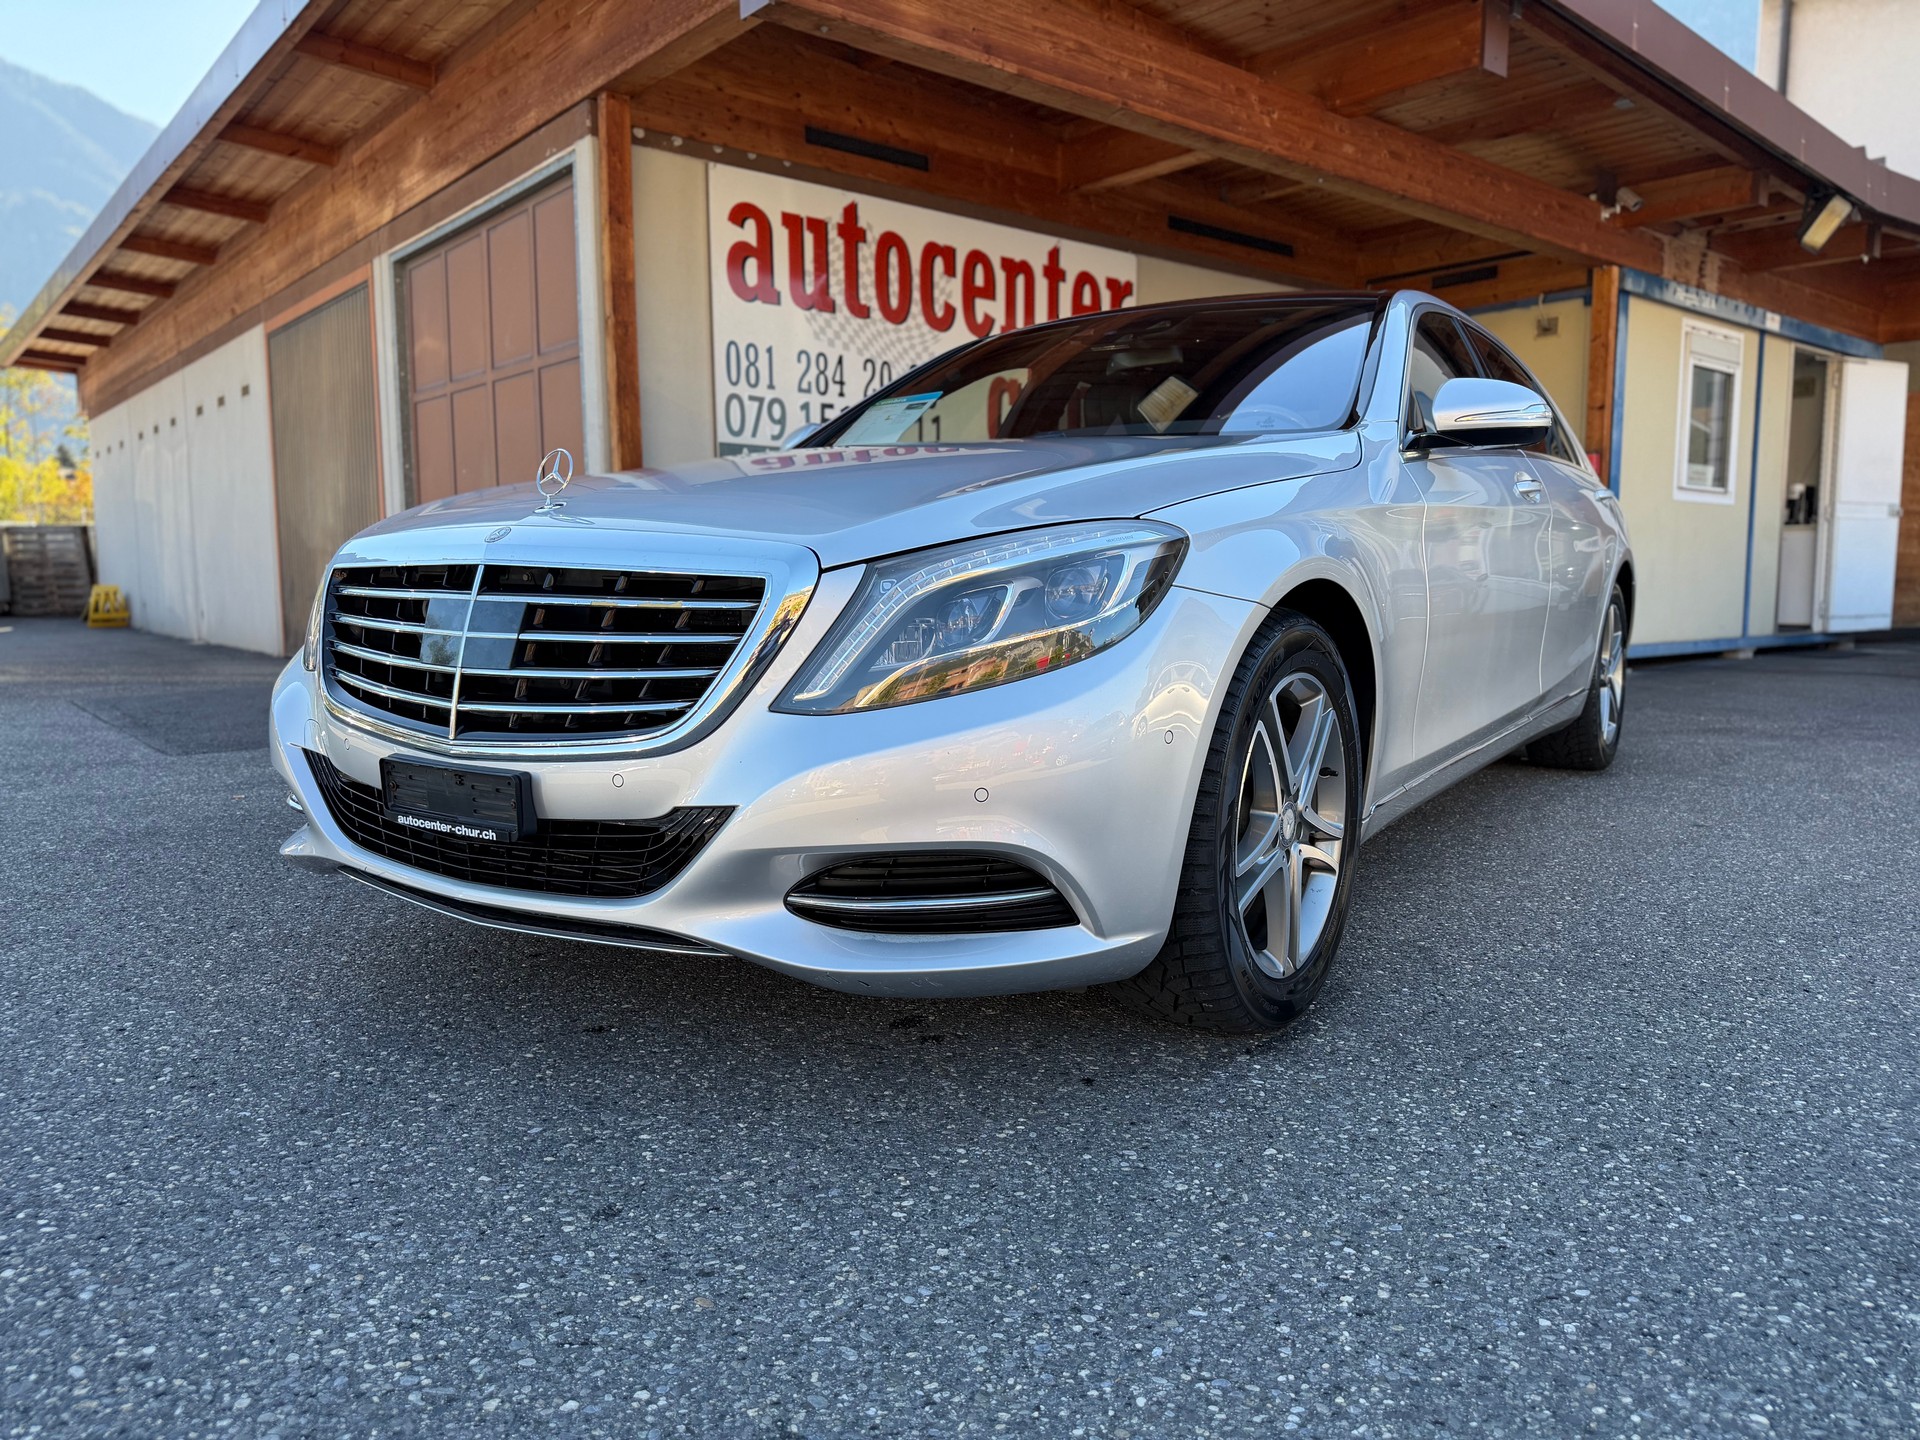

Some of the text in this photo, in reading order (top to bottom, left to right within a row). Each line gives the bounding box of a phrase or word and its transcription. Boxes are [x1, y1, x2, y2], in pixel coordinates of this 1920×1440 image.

[725, 340, 892, 398] 081 284 20
[725, 393, 787, 441] 079
[800, 401, 850, 425] 15
[397, 814, 497, 841] autocenter-chur.ch
